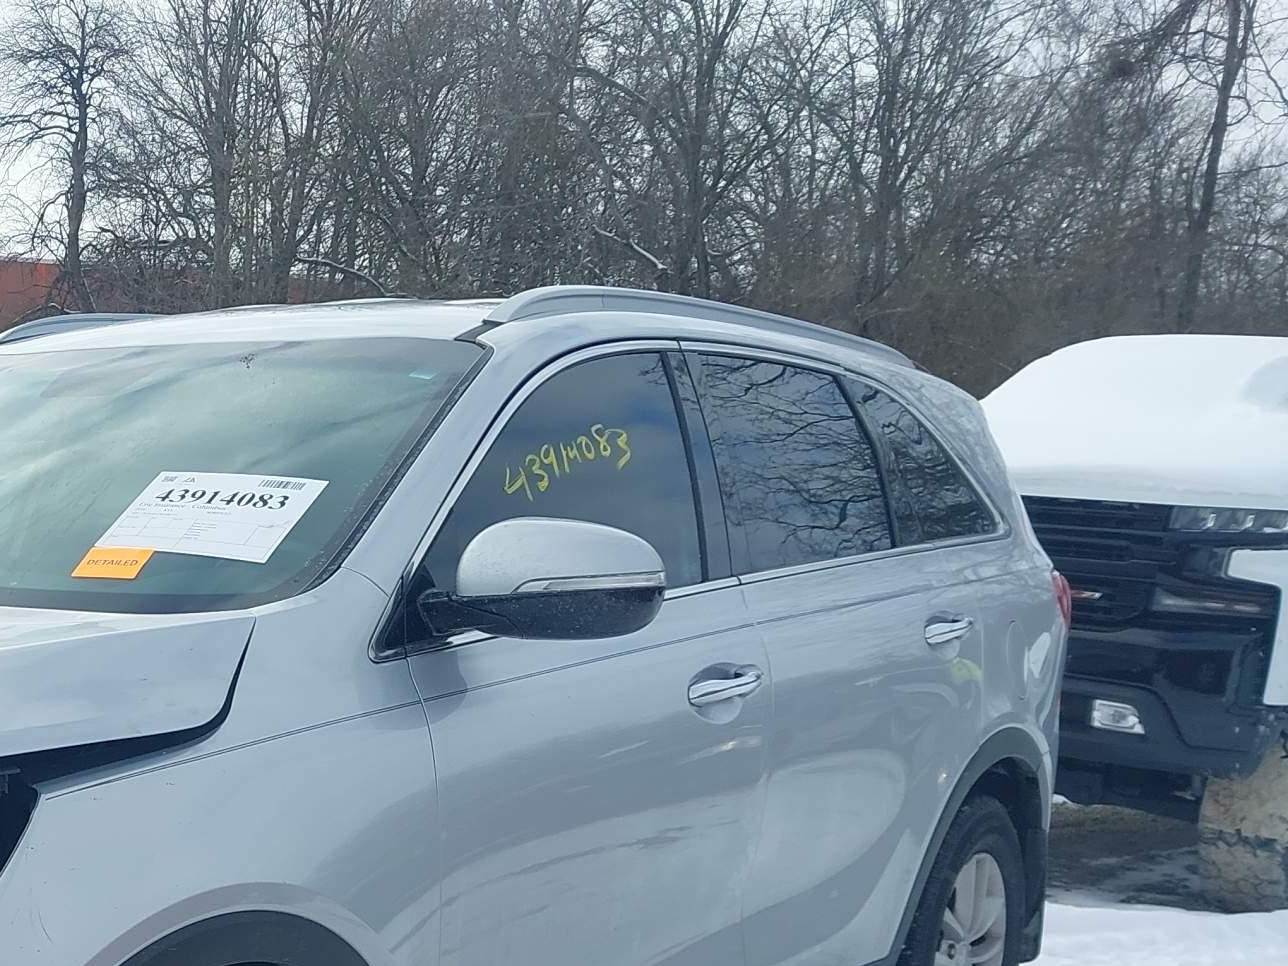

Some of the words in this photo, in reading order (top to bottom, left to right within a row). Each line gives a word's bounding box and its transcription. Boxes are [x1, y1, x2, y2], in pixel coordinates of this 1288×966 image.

[503, 423, 632, 502] 43914083
[155, 488, 291, 510] 43914083
[86, 558, 139, 567] DETAILED
